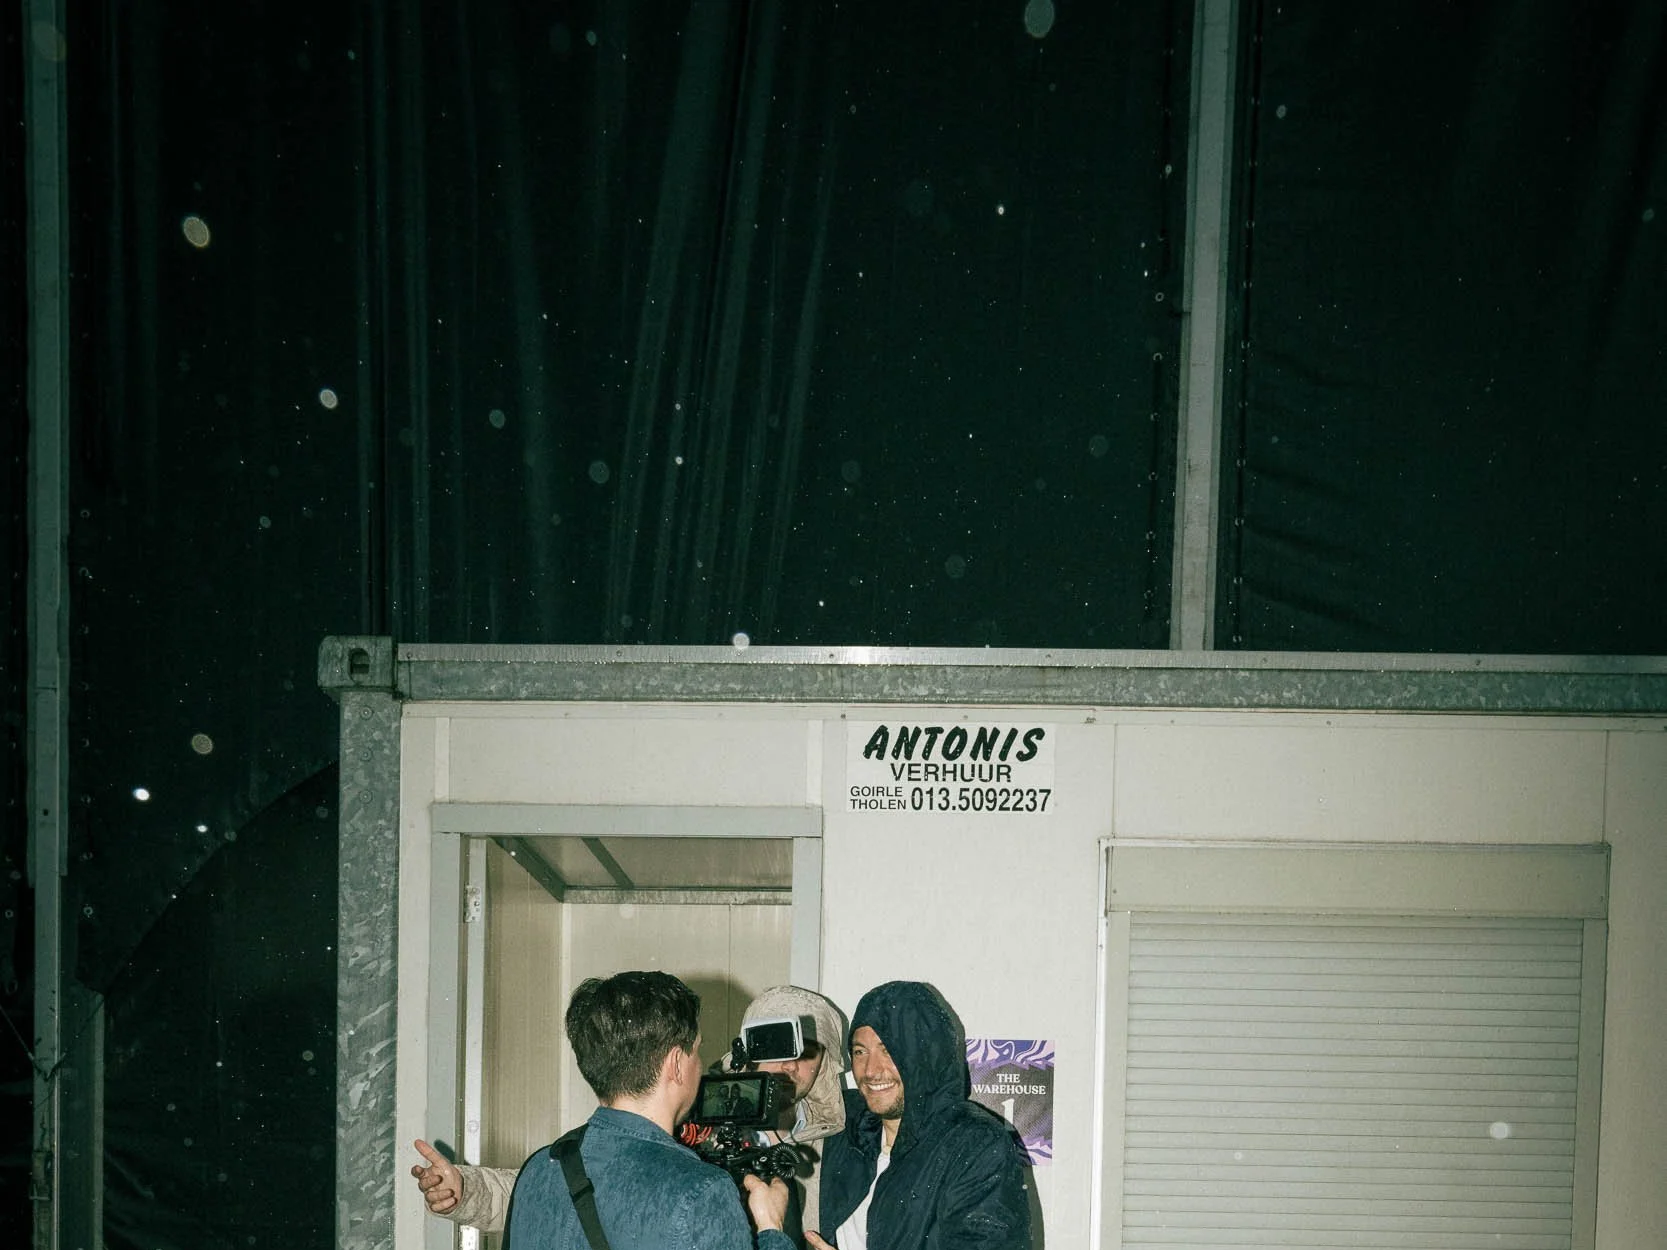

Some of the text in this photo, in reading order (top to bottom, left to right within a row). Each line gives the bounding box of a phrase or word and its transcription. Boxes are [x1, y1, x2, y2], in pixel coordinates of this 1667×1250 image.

[863, 725, 1045, 762] ANTONIS
[890, 763, 1012, 783] VERHUUR
[850, 786, 903, 797] GOIRLE
[850, 799, 906, 810] THOLEN
[911, 787, 1052, 812] 013.5092237
[996, 1073, 1020, 1083] THE
[972, 1084, 1046, 1095] WAREHOUSE
